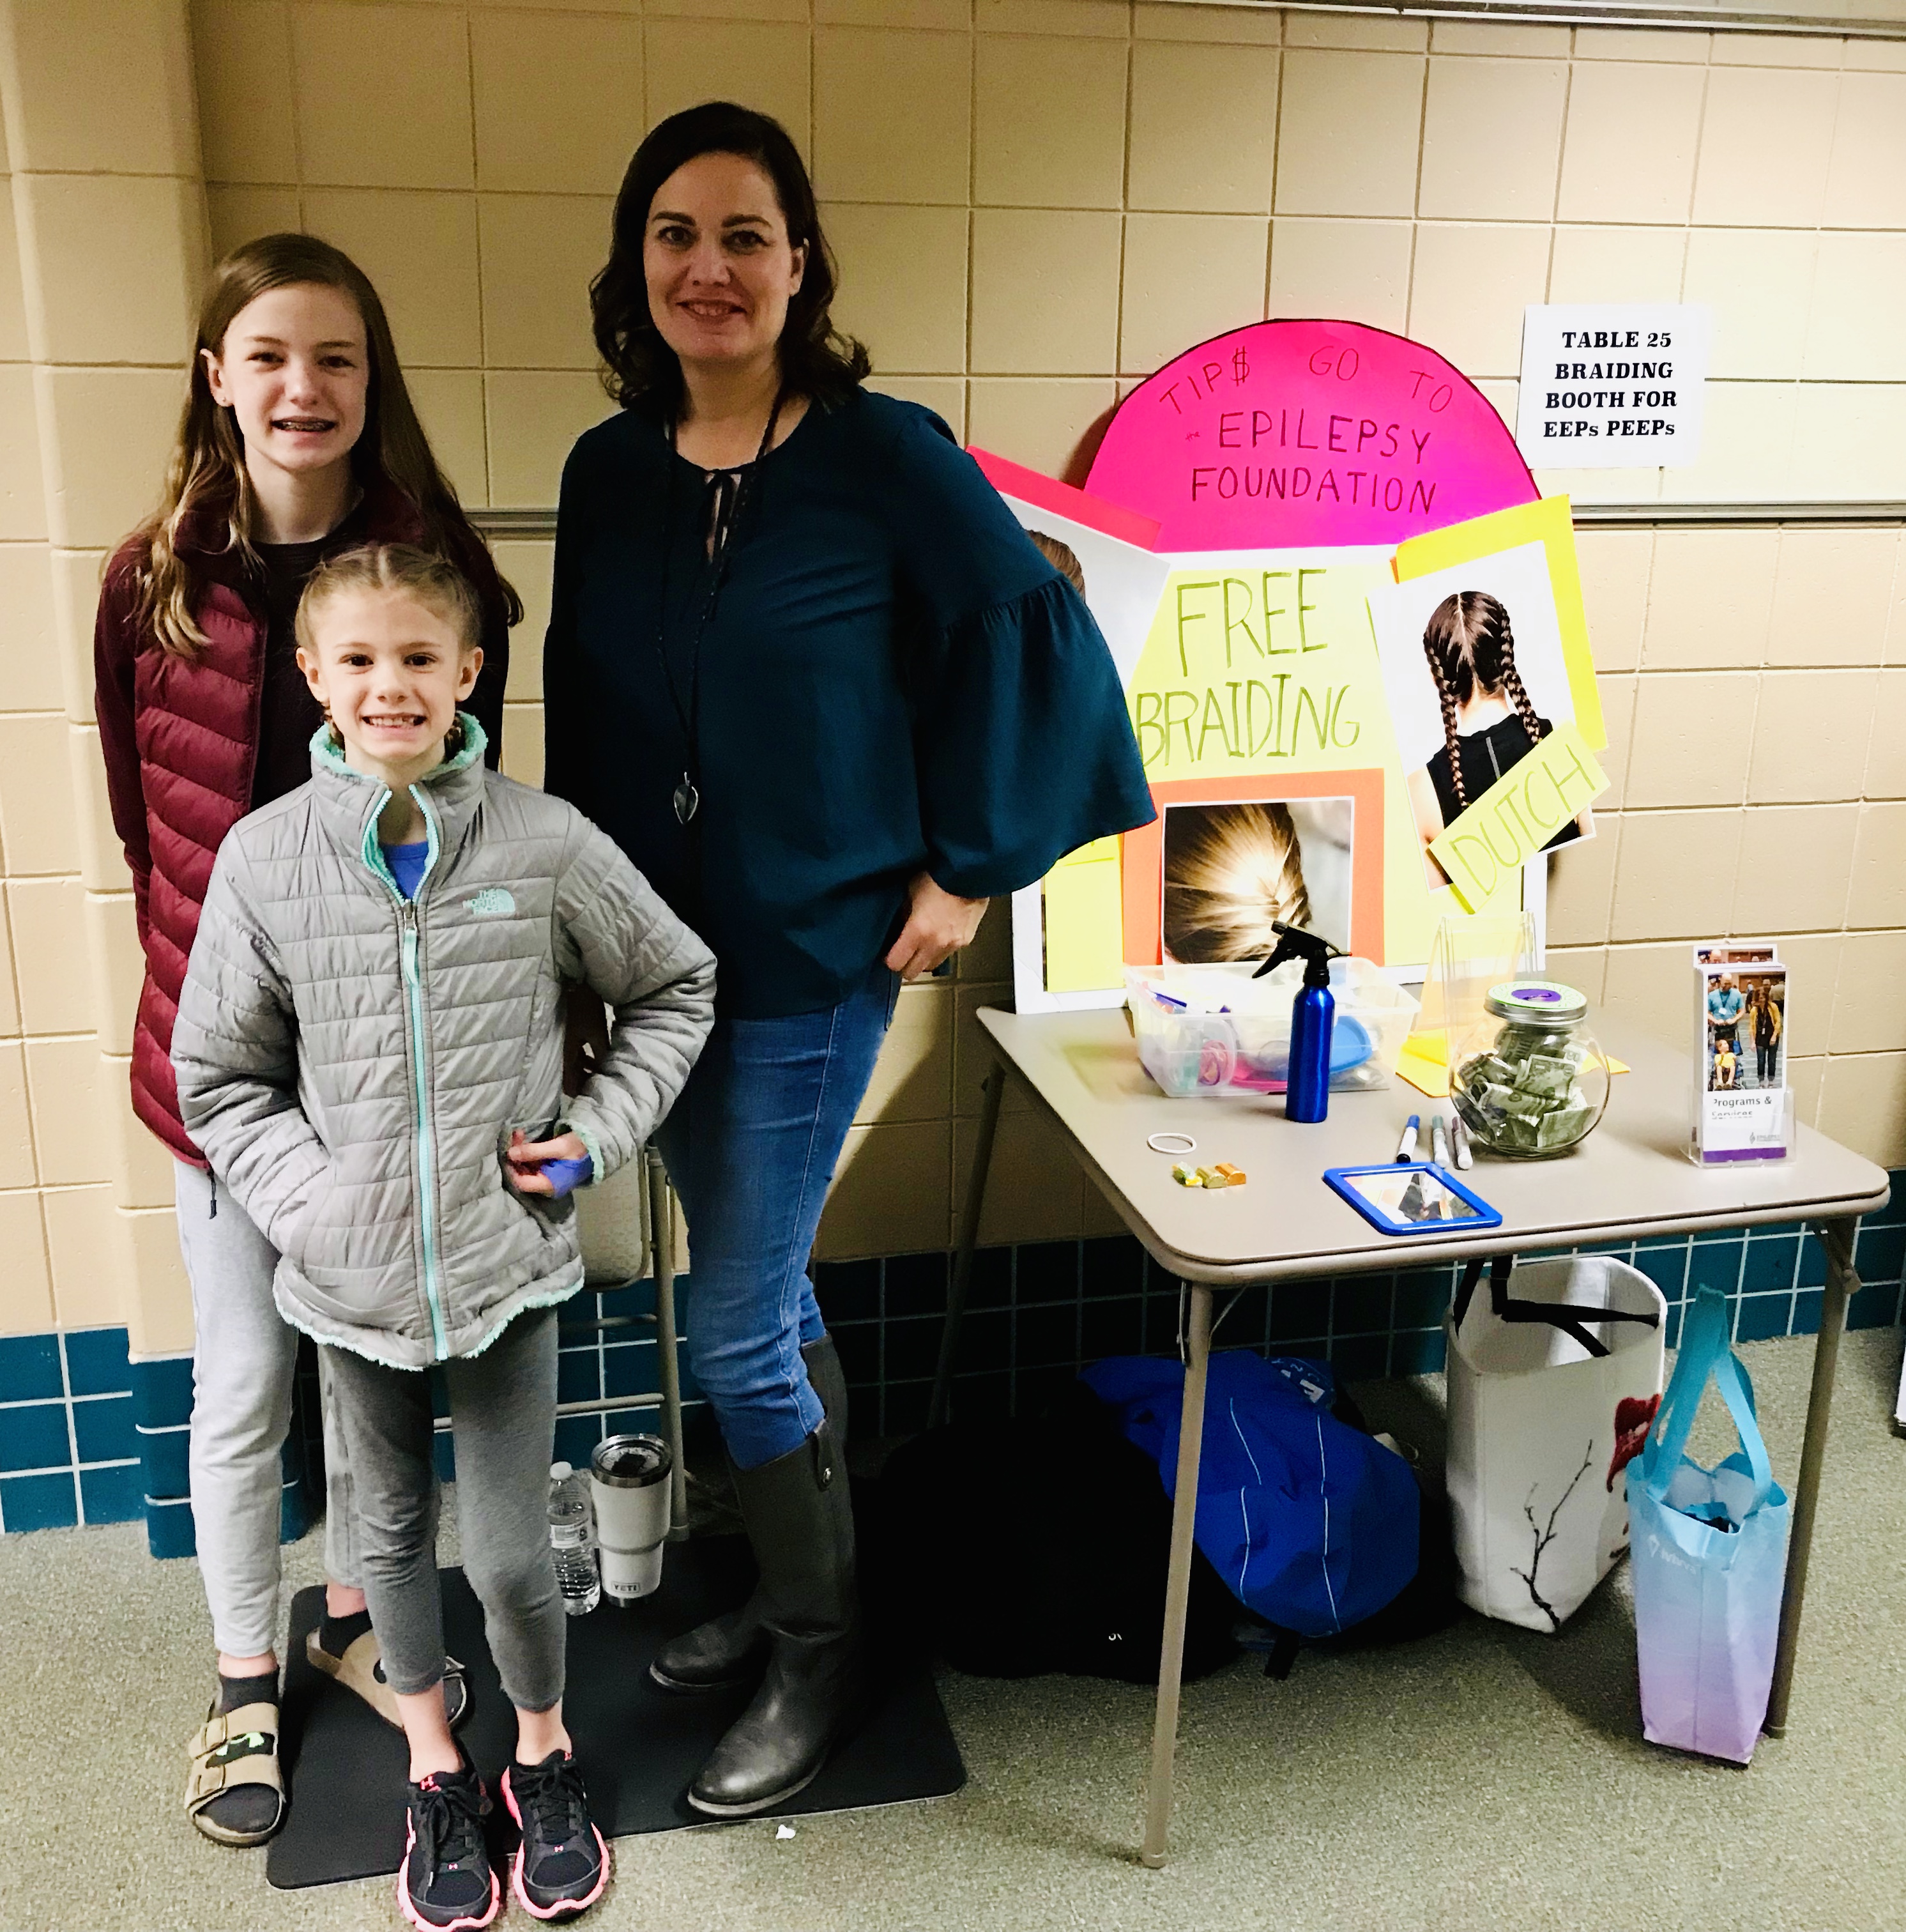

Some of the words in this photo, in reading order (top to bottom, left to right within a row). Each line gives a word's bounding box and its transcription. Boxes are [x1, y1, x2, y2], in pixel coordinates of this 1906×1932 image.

[1562, 332, 1639, 348] TABLE
[1647, 332, 1672, 348] 25
[1159, 346, 1250, 414] TIP$
[1309, 346, 1360, 381] GO
[1408, 370, 1452, 413] TO
[1554, 362, 1673, 379] BRAIDING
[1545, 391, 1626, 409] BOOTH
[1632, 390, 1677, 408] FOR
[1219, 409, 1431, 464] EPILEPSY
[1543, 421, 1599, 437] EEPs
[1606, 420, 1675, 436] PEEPs
[1192, 466, 1436, 514] FOUNDATION
[1177, 568, 1328, 677] FREE
[1136, 673, 1360, 767] BRAIDING
[1449, 744, 1596, 896] DUTCH
[1764, 1096, 1772, 1104] &
